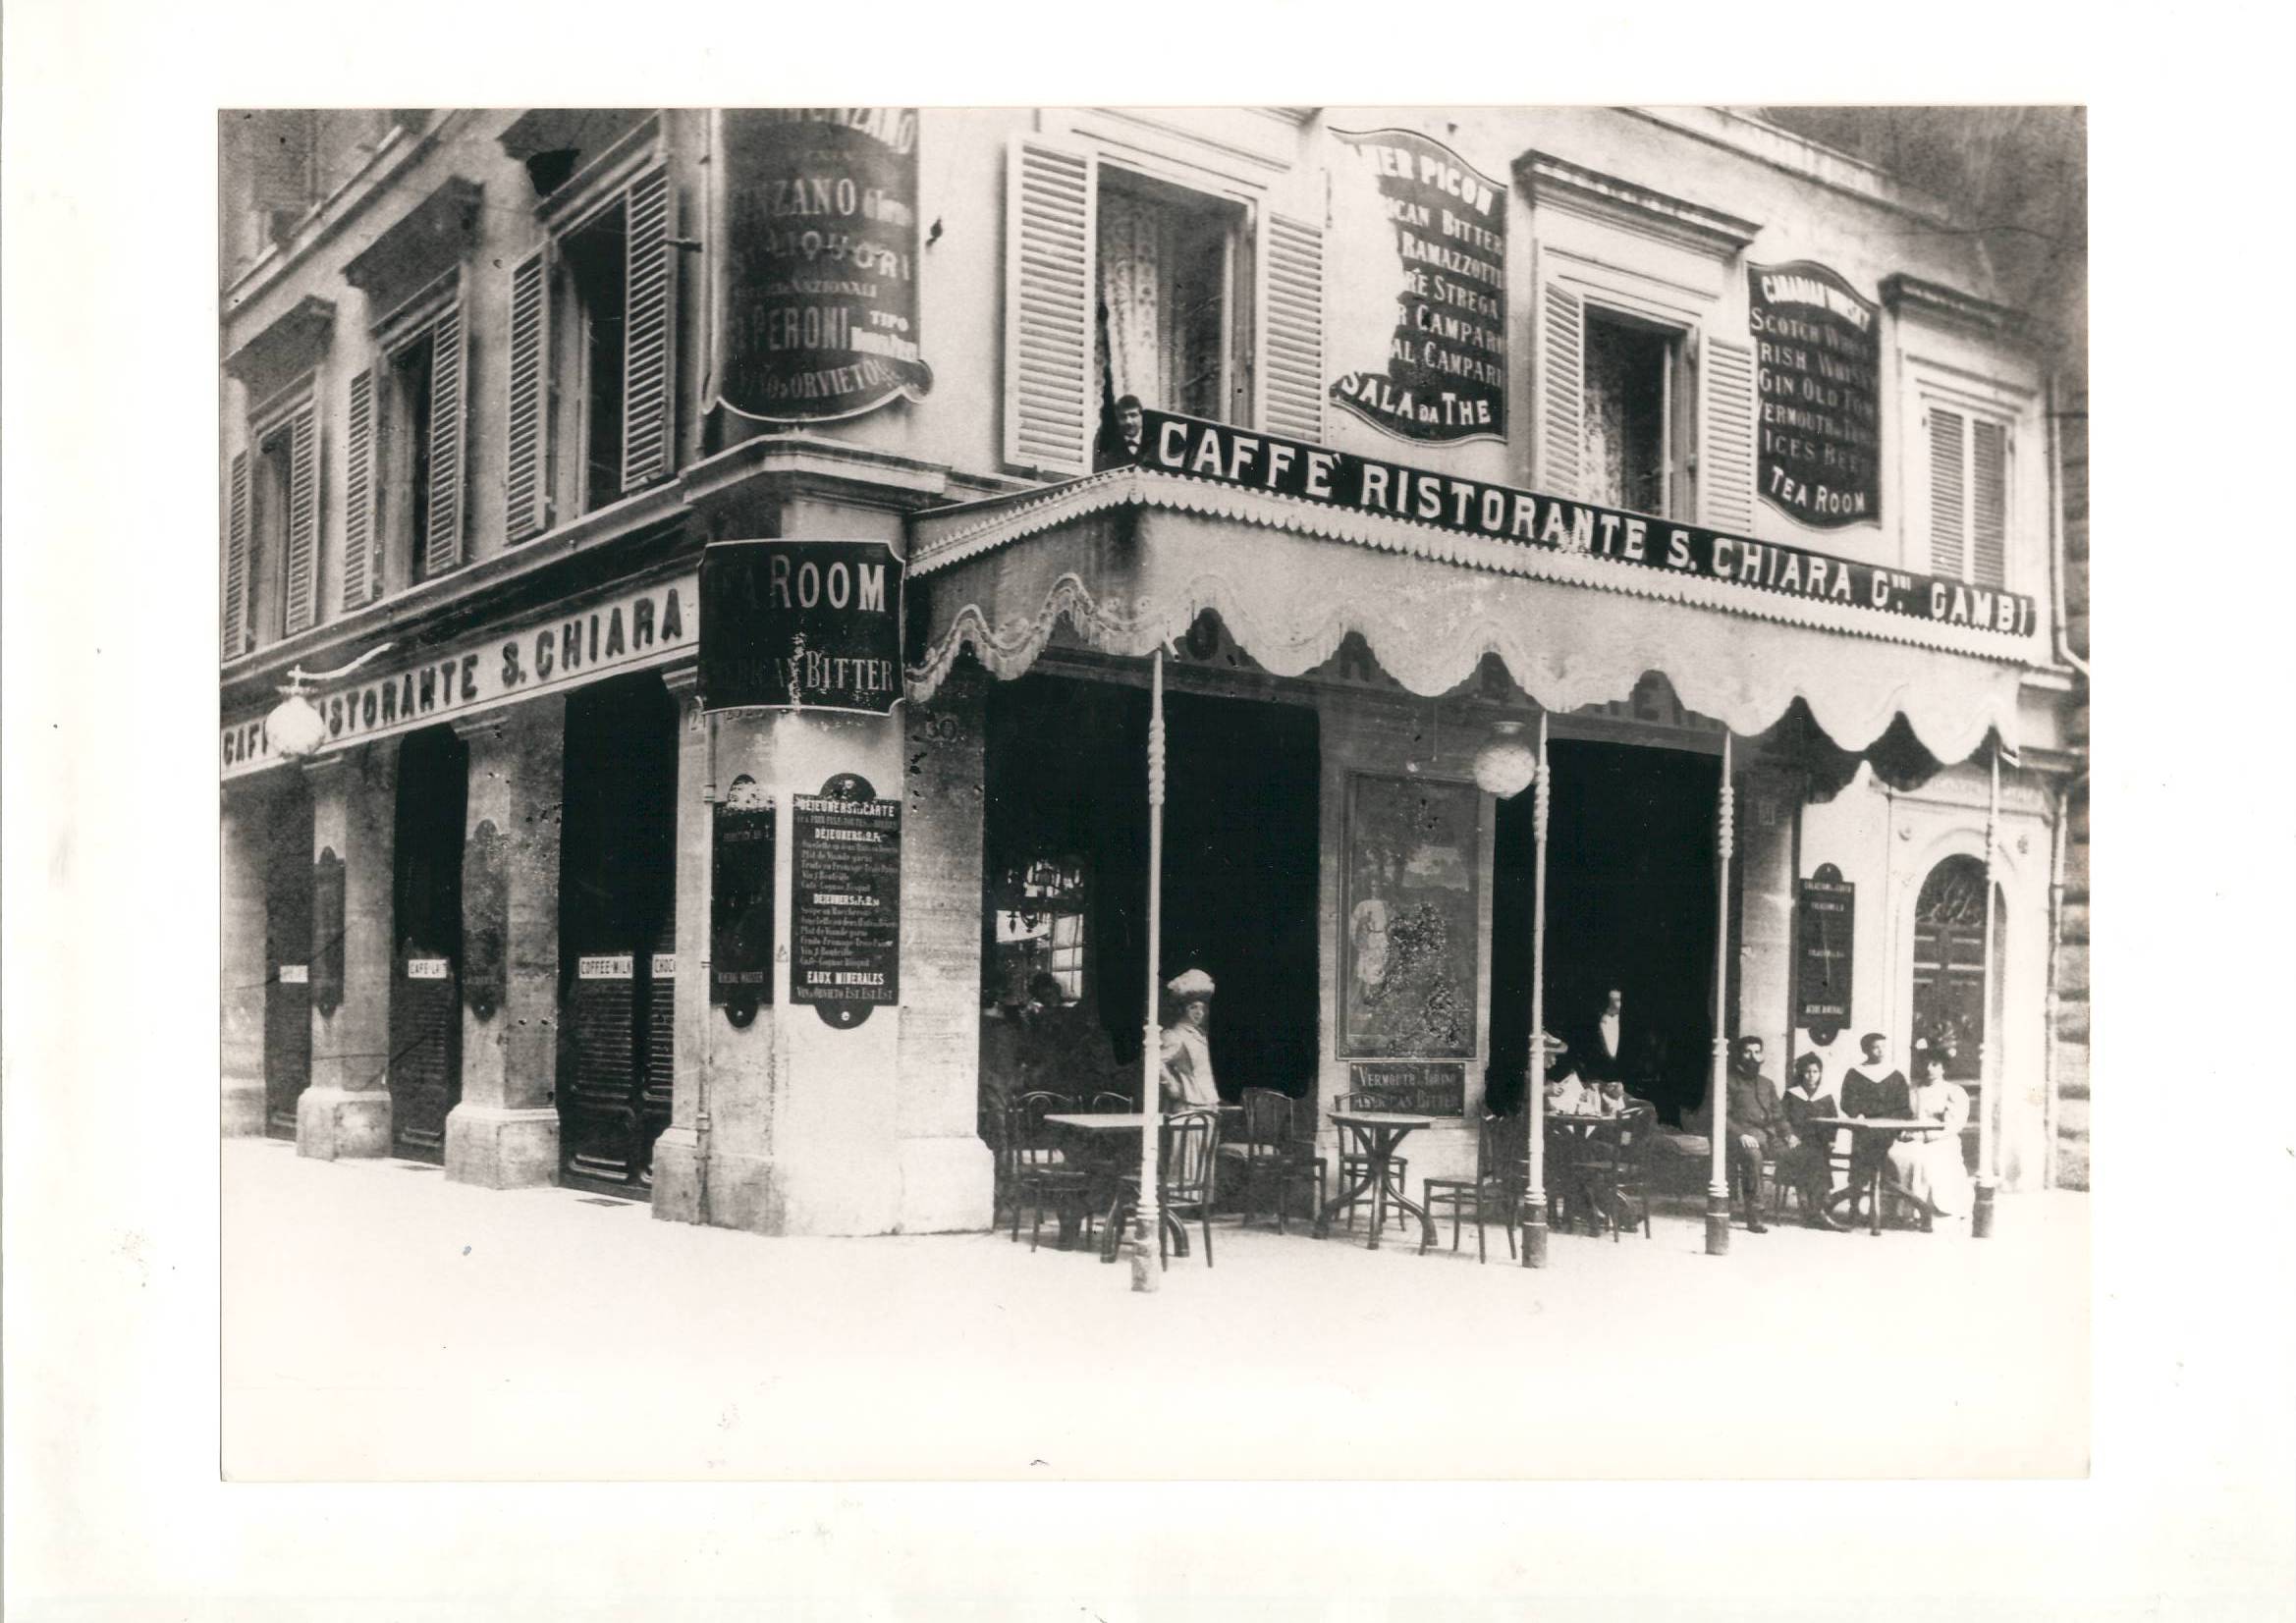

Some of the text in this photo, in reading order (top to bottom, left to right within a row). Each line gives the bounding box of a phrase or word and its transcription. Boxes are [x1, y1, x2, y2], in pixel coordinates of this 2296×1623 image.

[1420, 155, 1493, 216] PICON
[1442, 208, 1503, 256] BITTER
[1401, 230, 1504, 290] RAMAZZOTTI
[1433, 274, 1499, 320] STREGA
[1750, 305, 1821, 344] SCOTCH
[1424, 340, 1503, 387] CAMPARI
[1757, 341, 1808, 373] RISH
[1339, 369, 1414, 420] SALA
[1441, 393, 1492, 426] THE
[1758, 366, 1795, 397] GIN
[1801, 375, 1839, 408] OLD
[1765, 428, 1817, 464] ICES
[1769, 463, 1866, 515] TEA ROOM
[1360, 462, 1647, 561] RISTORANTE
[1666, 530, 1697, 570] S.
[1711, 538, 1852, 603] CHIARA
[1930, 581, 2029, 635] GAMBI
[769, 554, 886, 613] ROOM
[318, 653, 479, 737] ISTORANTE
[501, 640, 527, 687] S.
[535, 587, 683, 680] CHIARA
[805, 649, 894, 692] BITTER
[806, 970, 885, 987] EAUX MINERALES
